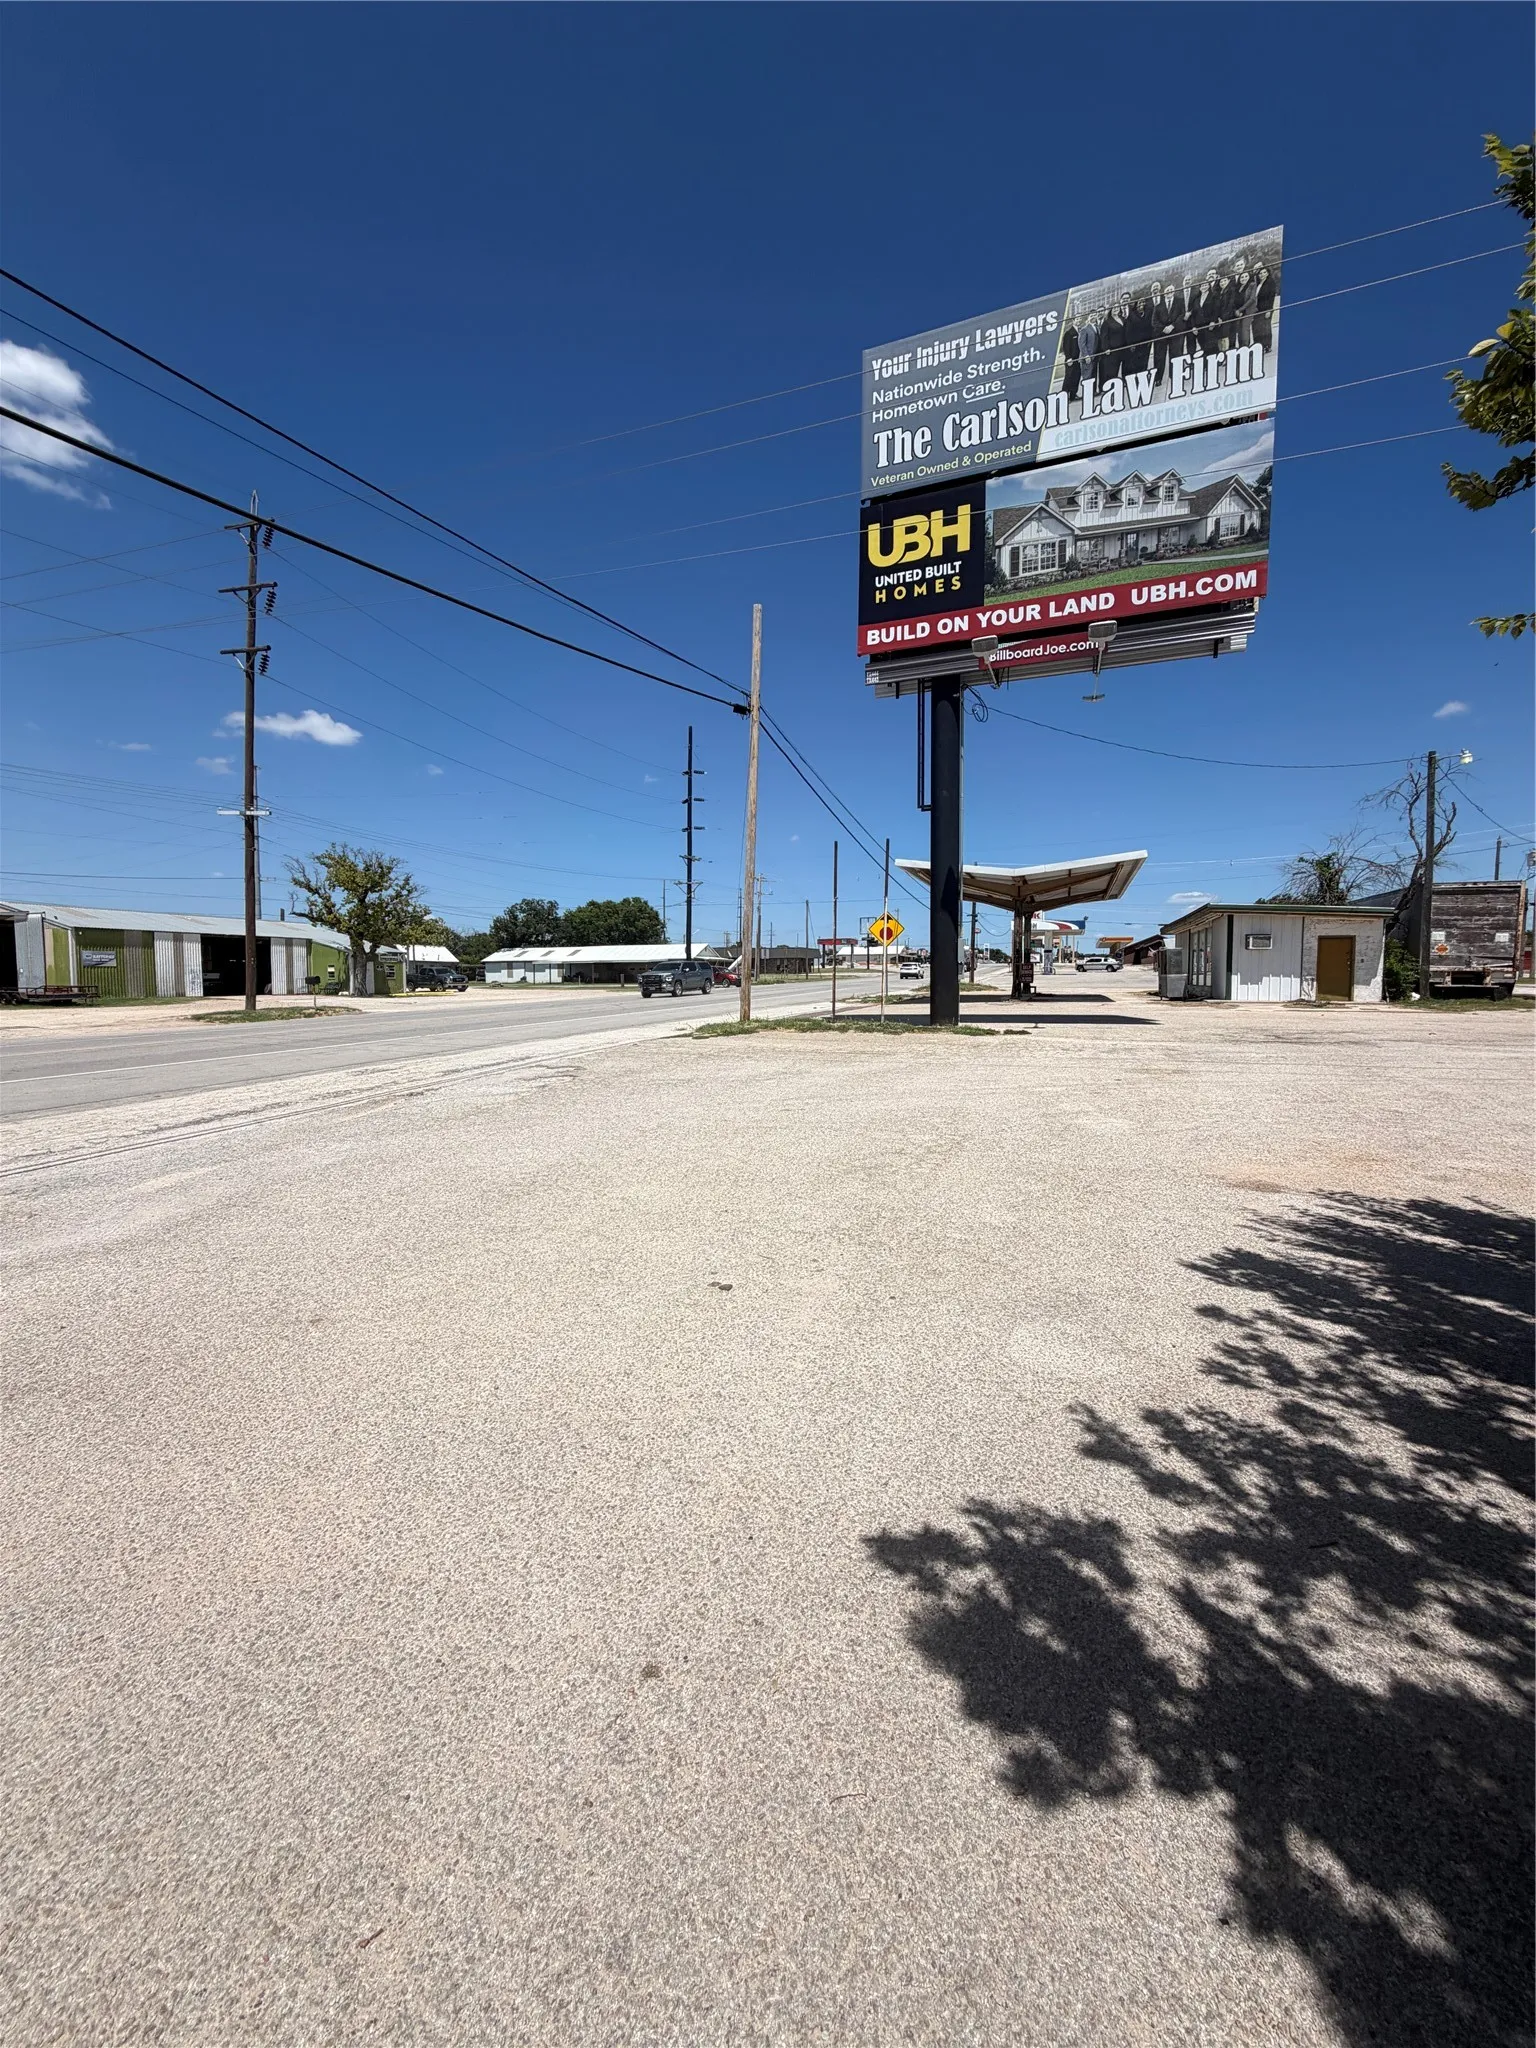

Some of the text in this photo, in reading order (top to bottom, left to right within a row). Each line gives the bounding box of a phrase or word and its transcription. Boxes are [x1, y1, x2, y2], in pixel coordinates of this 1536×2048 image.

[872, 310, 1058, 381] Your Injury Lawyers
[872, 347, 1046, 405] Nationwide Strength.
[872, 380, 1006, 423] Hometown Care.
[873, 342, 1265, 469] The Carlson Law Firm
[1054, 389, 1253, 447] carlsonattorneys.com
[871, 440, 1032, 487] Veteran Owned & Operated
[868, 503, 971, 568] UBH
[875, 560, 962, 588] UNITED BUILT
[875, 575, 962, 604] HOMES
[866, 569, 1257, 646] BUILD ON YOUR LAND UBH.COM
